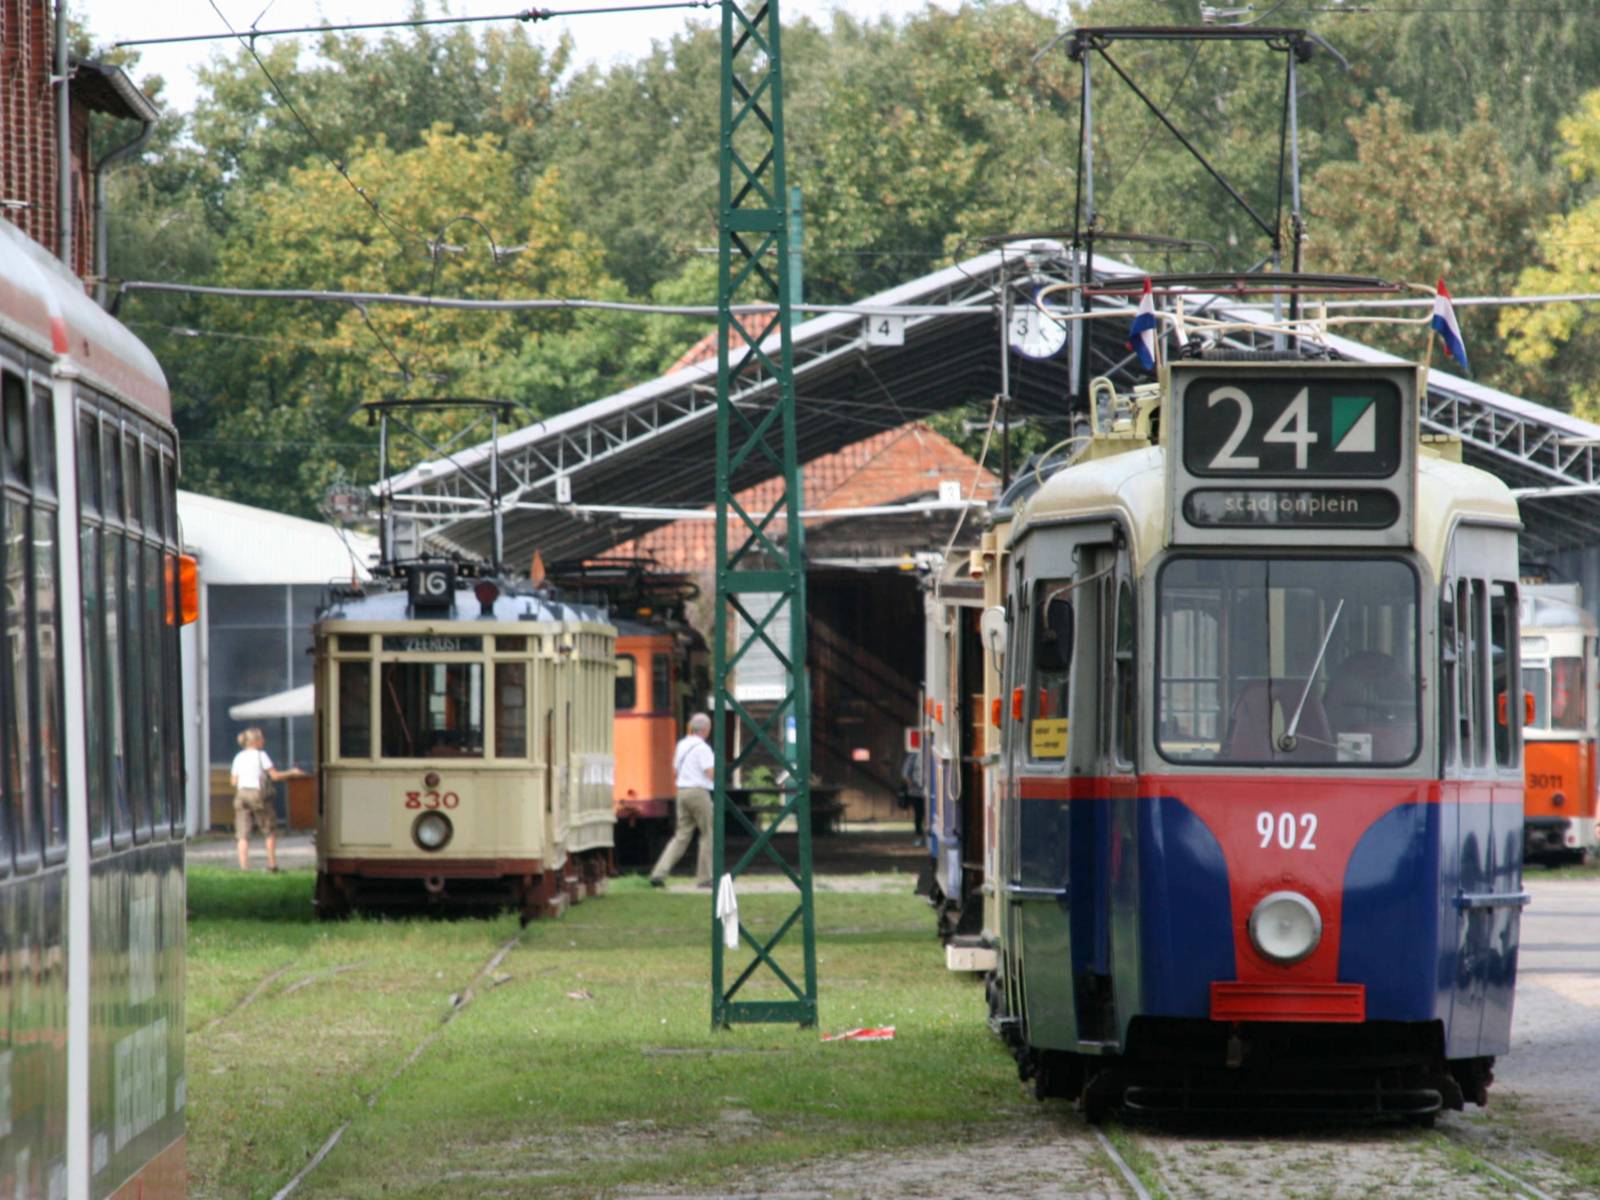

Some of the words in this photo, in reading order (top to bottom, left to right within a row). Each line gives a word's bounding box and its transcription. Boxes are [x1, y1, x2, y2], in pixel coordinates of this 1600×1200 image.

[878, 319, 890, 336] 4
[1016, 318, 1029, 336] 3
[1207, 386, 1318, 470] 24
[1224, 494, 1359, 516] stadionplein
[418, 571, 447, 595] 16
[1528, 774, 1563, 789] 3011
[404, 791, 460, 810] 830
[1256, 811, 1318, 850] 902
